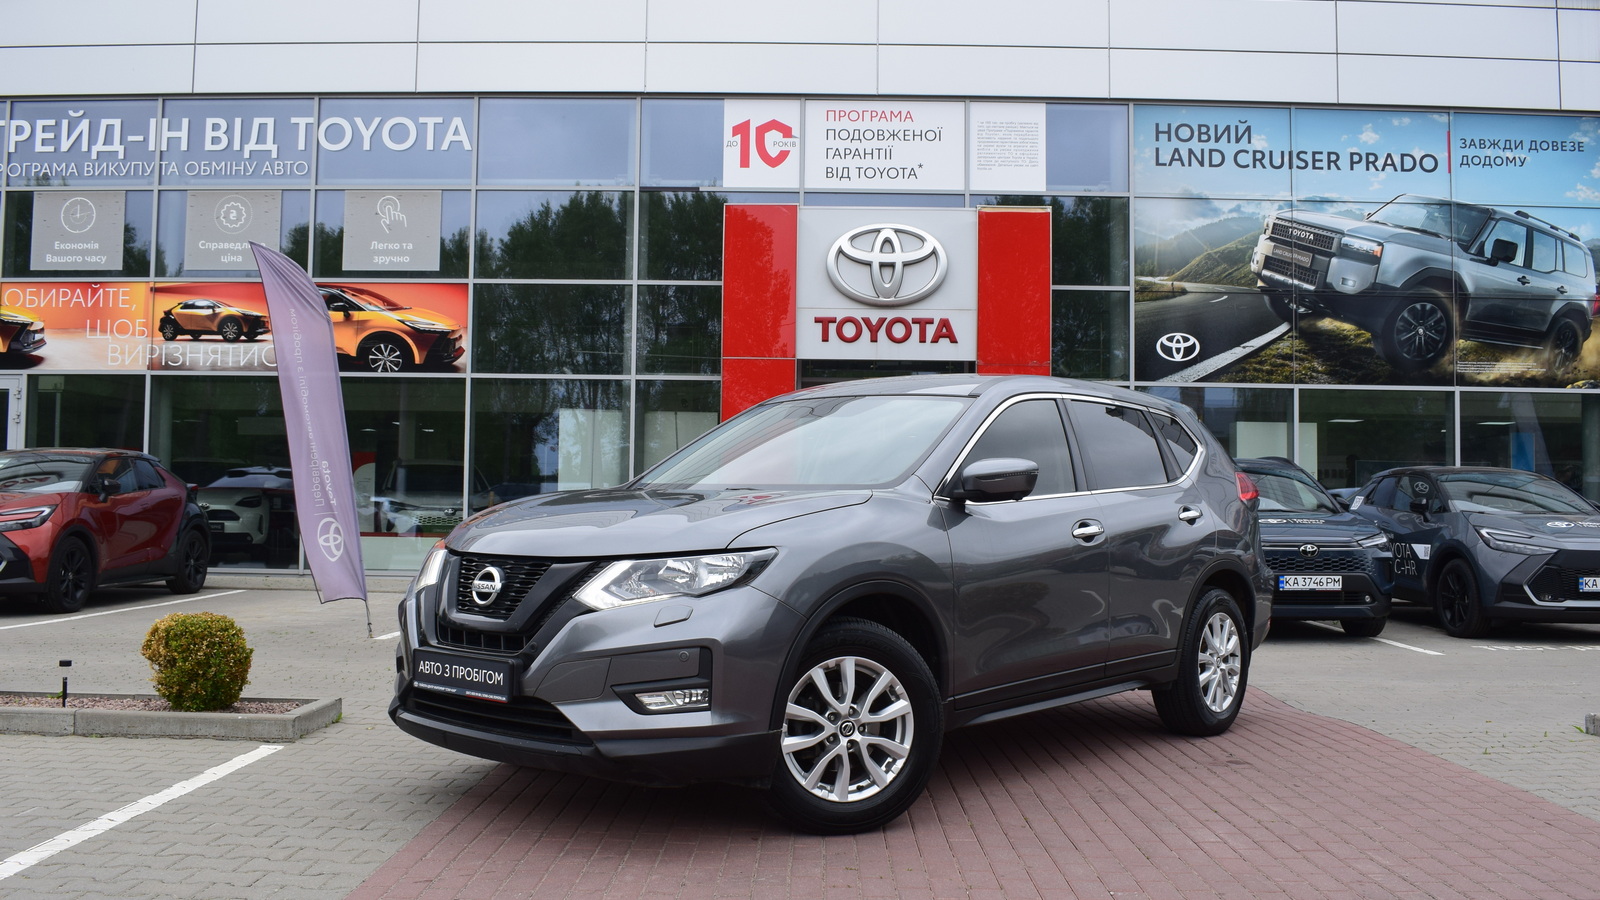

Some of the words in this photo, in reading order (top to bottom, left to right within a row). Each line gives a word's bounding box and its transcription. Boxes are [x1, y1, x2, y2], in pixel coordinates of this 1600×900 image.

[826, 110, 914, 122] ПРОГРАМА
[0, 110, 190, 160] РЕЙД-ІН
[204, 117, 278, 159] ВІД
[291, 116, 473, 151] TOYOTA
[826, 126, 943, 143] ПОДОВЖЕНОЇ
[1155, 119, 1252, 144] НОВИЙ
[726, 140, 738, 148] ДО
[773, 140, 797, 148] РОКІВ
[1460, 138, 1524, 152] ЗАВЖДИ
[1528, 140, 1585, 153] ДОВЕЗЕ
[825, 145, 894, 160] ГАРАНТІЇ
[1155, 147, 1226, 168] LAND
[1233, 149, 1342, 171] CRUISER
[1350, 152, 1439, 173] PRADO
[84, 162, 155, 177] ВИКУПУ
[159, 161, 179, 176] ТА
[185, 161, 257, 176] ОБМІНУ
[261, 160, 309, 176] АВТО
[1460, 155, 1527, 168] ДОДОМУ
[825, 166, 851, 181] ВІД
[1289, 228, 1314, 240] TOYOTA
[54, 241, 99, 250] Економія
[198, 241, 266, 251] Справедл
[370, 241, 400, 250] Легко
[46, 254, 83, 263] Вашого
[84, 256, 107, 264] часу
[221, 253, 243, 263] ціна
[373, 256, 410, 265] зручно
[4, 284, 137, 311] ОБИРАЙТЕ,
[86, 319, 148, 342] ЩОБ
[814, 316, 959, 344] TOYOTA
[107, 344, 277, 367] ВИРІЗНЯТИС
[1390, 542, 1412, 558] YOTA
[1394, 559, 1418, 575] C-HR
[1284, 577, 1300, 587] KA
[1301, 577, 1324, 587] 3746
[1325, 577, 1341, 587] PM
[418, 660, 442, 676] АВТО
[443, 665, 450, 677] З
[452, 665, 504, 685] ПРОБІГОМ
